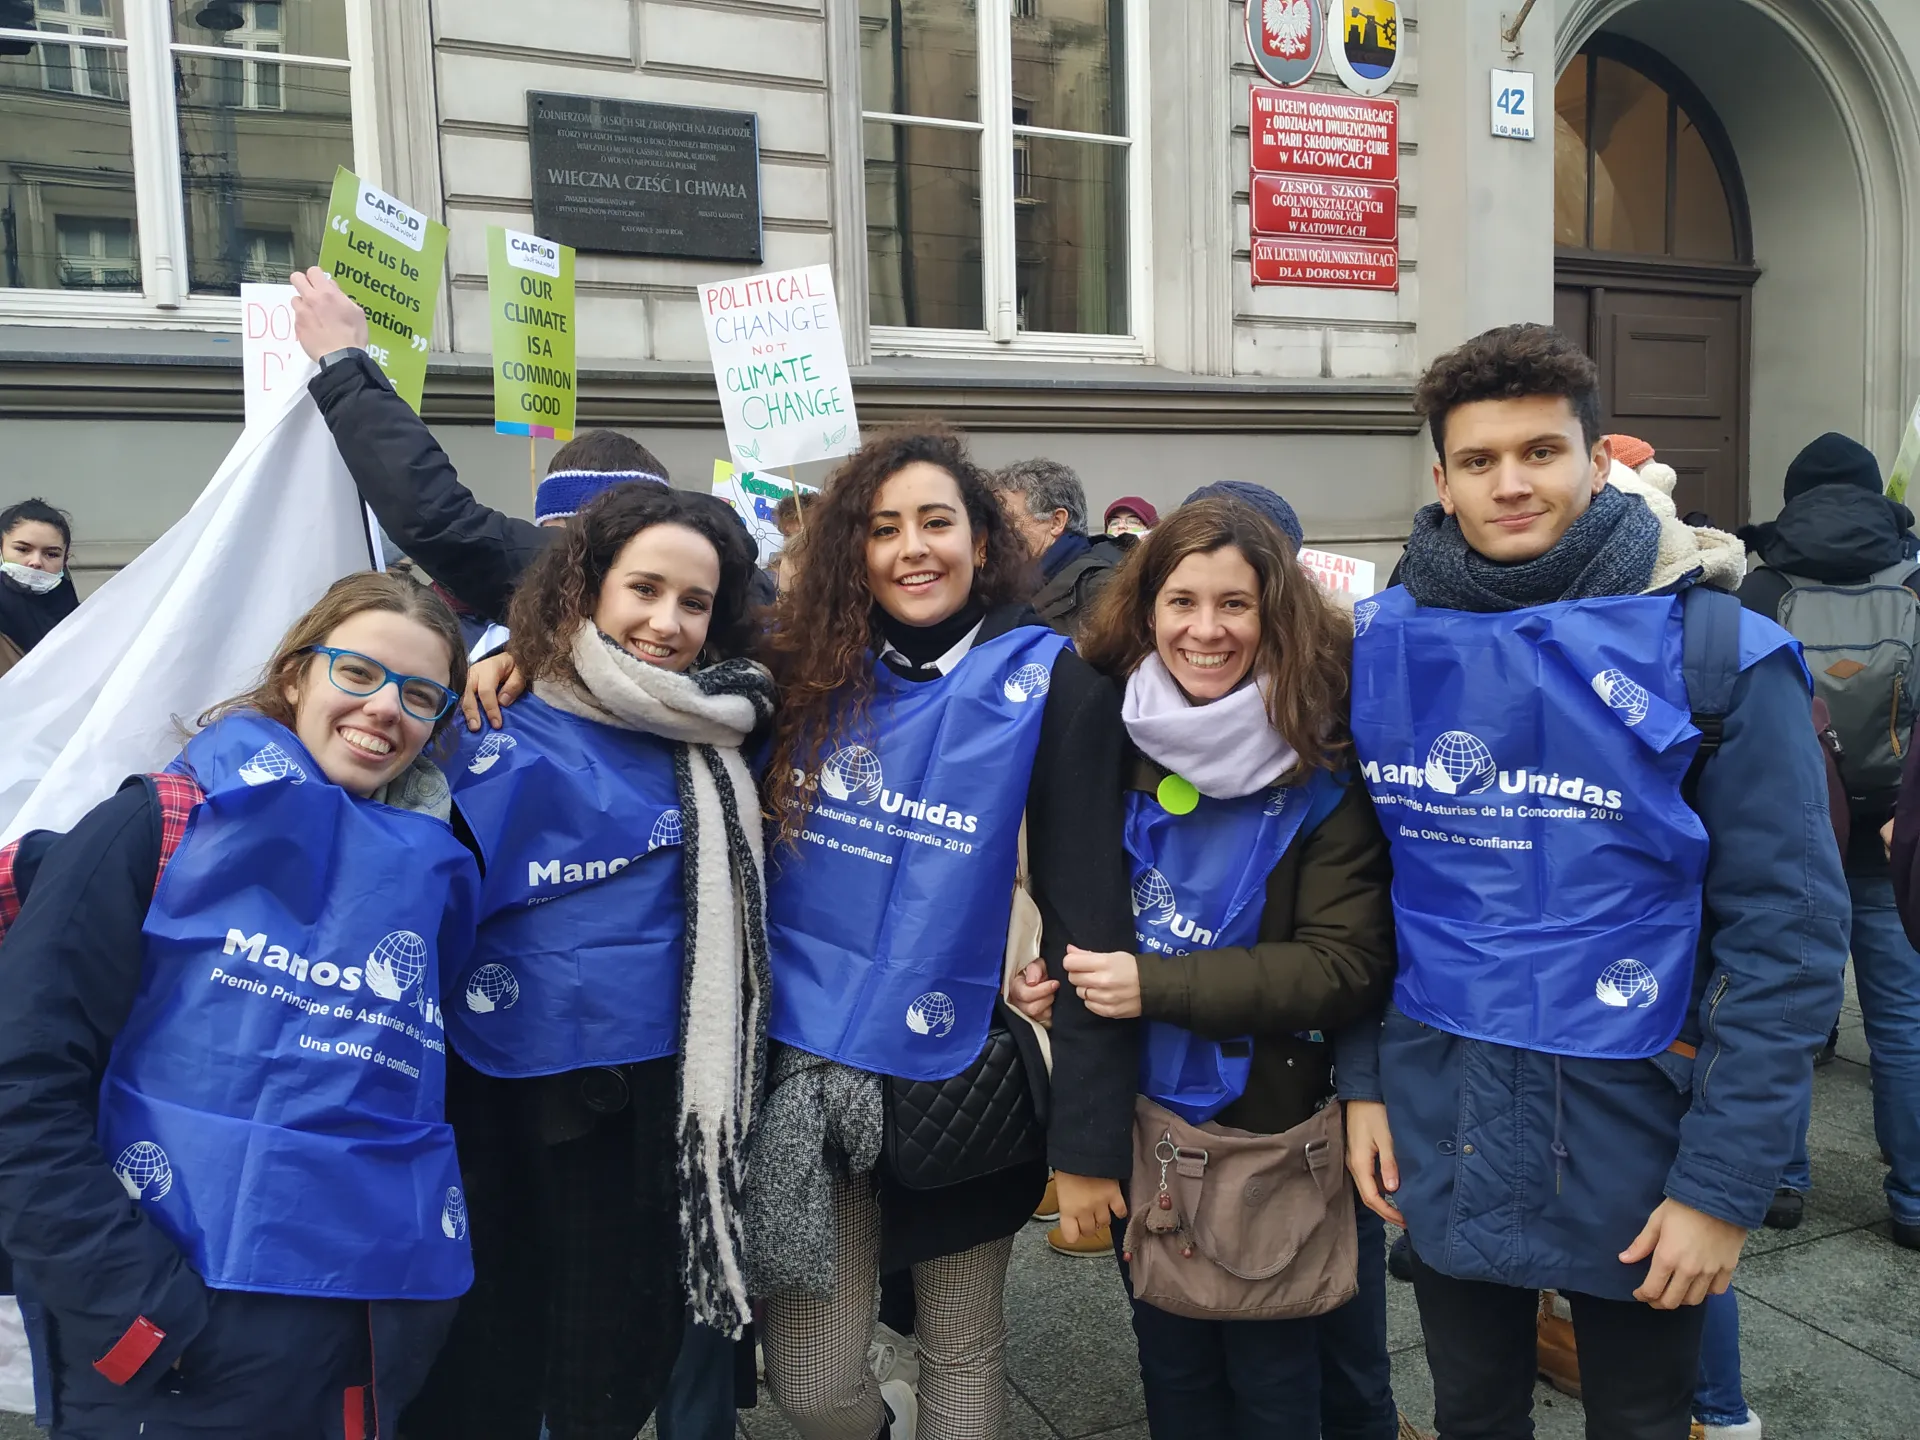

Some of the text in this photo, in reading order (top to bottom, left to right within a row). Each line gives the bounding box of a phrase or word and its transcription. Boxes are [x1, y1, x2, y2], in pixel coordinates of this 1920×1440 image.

[1256, 97, 1272, 112] VIII
[1275, 98, 1308, 115] LICEUM
[1496, 87, 1525, 115] 42
[648, 119, 693, 133] ZBROJNYCH
[694, 126, 705, 134] NA
[707, 125, 751, 138] ZACHODZIE
[1273, 115, 1323, 133] ODDZIAŁAMI
[1511, 127, 1530, 136] MAJA
[1263, 131, 1276, 145] im.
[1277, 132, 1302, 148] MARII
[1293, 150, 1373, 170] KATOWICACH
[548, 168, 747, 199] WIECZNA CZEŚĆ I CHWAŁA
[1280, 180, 1373, 199] ZESPÓŁ SZKÓŁ
[364, 191, 420, 231] CAFOD
[1291, 207, 1362, 222] DLA DOROSŁYCH
[1288, 221, 1367, 236] W KATOWICACH
[511, 238, 555, 260] CAFOD
[1257, 246, 1273, 260] XIX
[1274, 247, 1307, 262] LICEUM
[378, 250, 397, 270] us
[400, 258, 419, 282] be
[1279, 267, 1376, 280] DLA DOROSŁYCH
[334, 260, 421, 313] protectors
[520, 276, 552, 301] OUR
[707, 273, 825, 315] POLITICAL
[504, 301, 567, 333] CLIMATE
[715, 303, 830, 344] CHANGE
[528, 335, 553, 358] IS A
[752, 342, 787, 356] NOT
[502, 361, 571, 391] COMMON
[727, 354, 820, 393] CLIMATE
[521, 392, 561, 416] GOOD
[742, 387, 845, 431] CHANGE
[1303, 551, 1356, 576] CLEAN
[1499, 769, 1622, 809] Unidas
[879, 788, 978, 833] Unidas
[1424, 802, 1477, 817] Asturias
[1481, 805, 1497, 817] de
[1500, 805, 1514, 818] la
[1517, 805, 1586, 819] Concordia
[1590, 807, 1624, 821] 2010
[815, 804, 858, 825] Asturias
[859, 816, 874, 830] de
[874, 820, 885, 833] la
[887, 824, 942, 847] Concordia
[944, 838, 972, 855] 2010
[1399, 824, 1533, 850] Una ONG de confianza
[801, 829, 825, 845] ONG
[826, 837, 840, 849] de
[841, 843, 893, 865] confianza
[528, 853, 645, 887] Mano
[1170, 913, 1222, 947] Uni
[1147, 936, 1161, 950] de
[1162, 943, 1173, 955] la
[222, 928, 364, 991] Manos
[210, 968, 268, 995] Premio
[333, 1004, 353, 1020] de
[355, 1008, 406, 1032] Asturias
[405, 1023, 414, 1037] de
[413, 1026, 420, 1040] la
[299, 1034, 420, 1079] Una ONG de confianza
